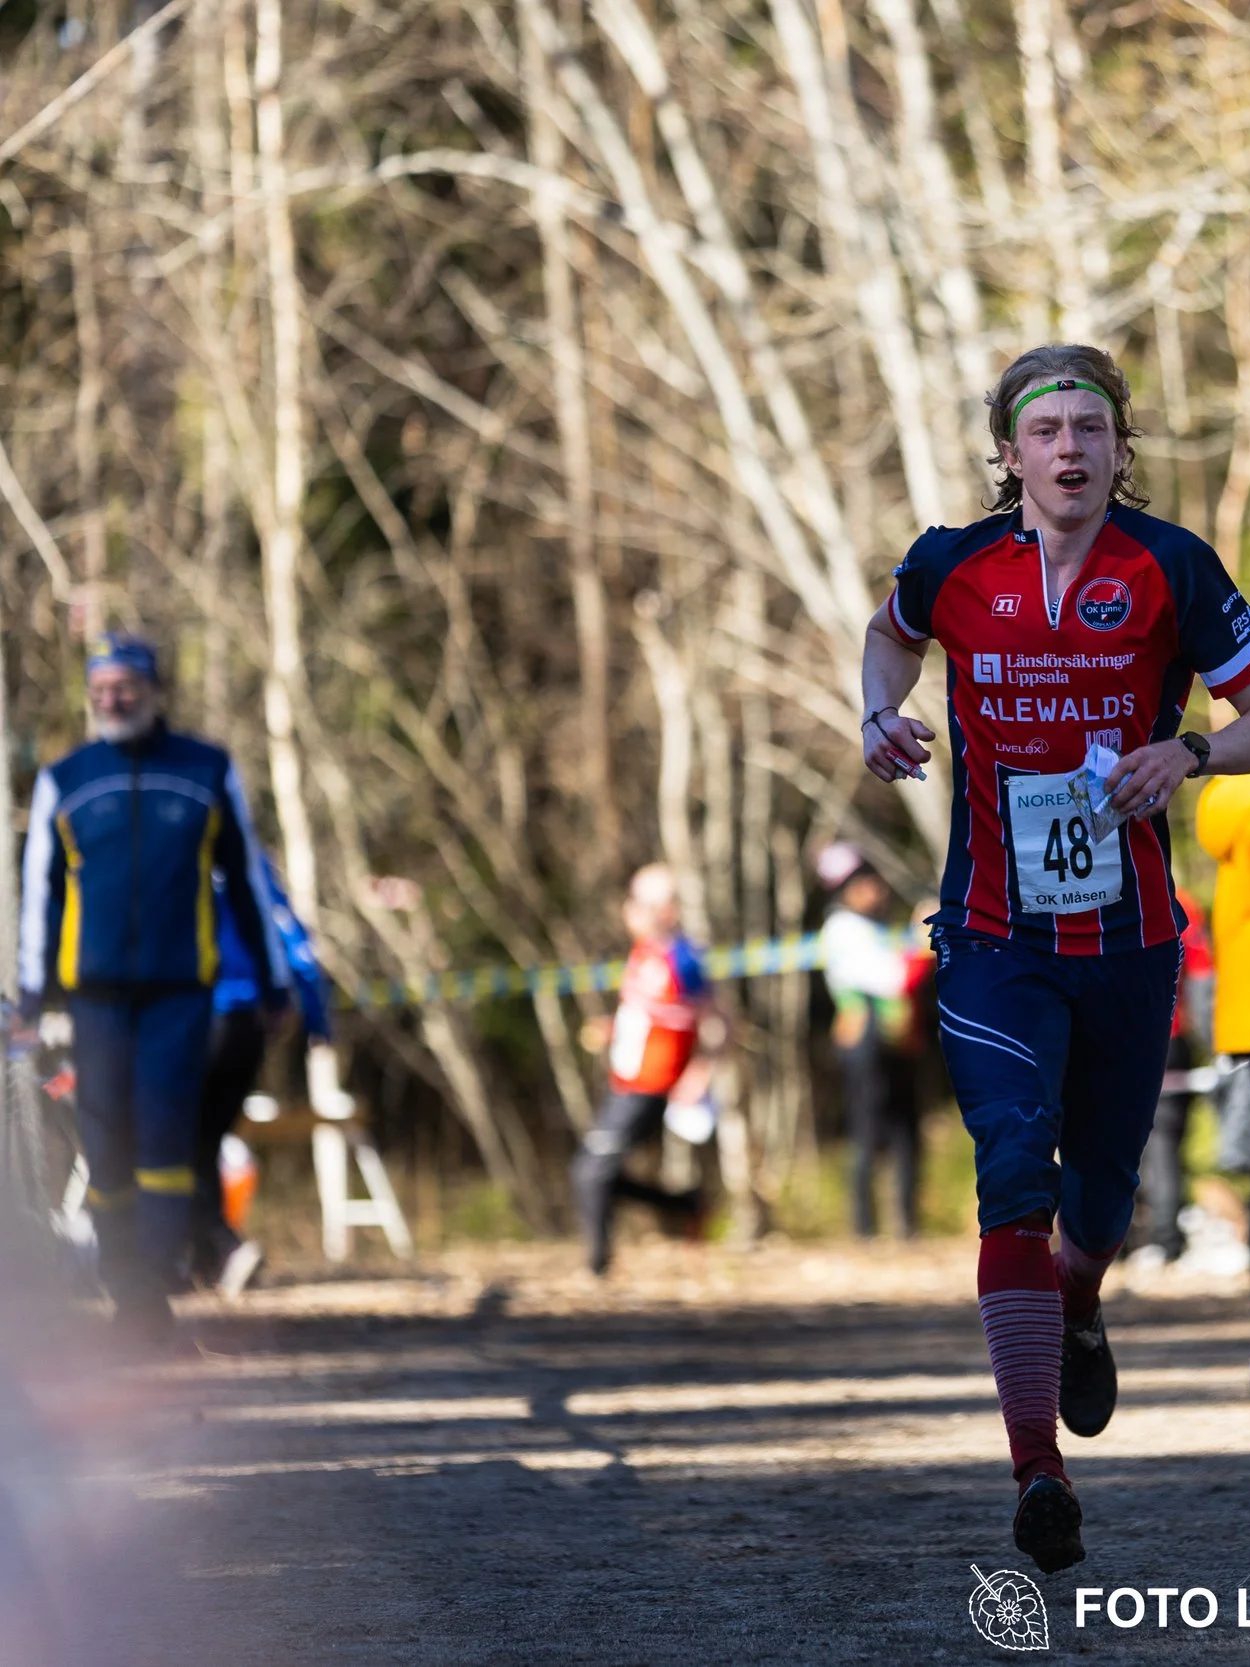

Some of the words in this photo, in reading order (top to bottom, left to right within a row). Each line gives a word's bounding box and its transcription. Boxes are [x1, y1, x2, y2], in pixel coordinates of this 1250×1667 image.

[1086, 605, 1099, 614] OK
[1101, 604, 1122, 613] Linné
[1006, 653, 1136, 670] Länsförsäkringar
[1007, 670, 1070, 687] Uppsala
[980, 693, 1135, 722] ALEWALDS
[995, 742, 1042, 755] LIVELOX
[1044, 816, 1093, 883] 48
[1036, 894, 1058, 905] OK
[1062, 890, 1107, 905] Måsen
